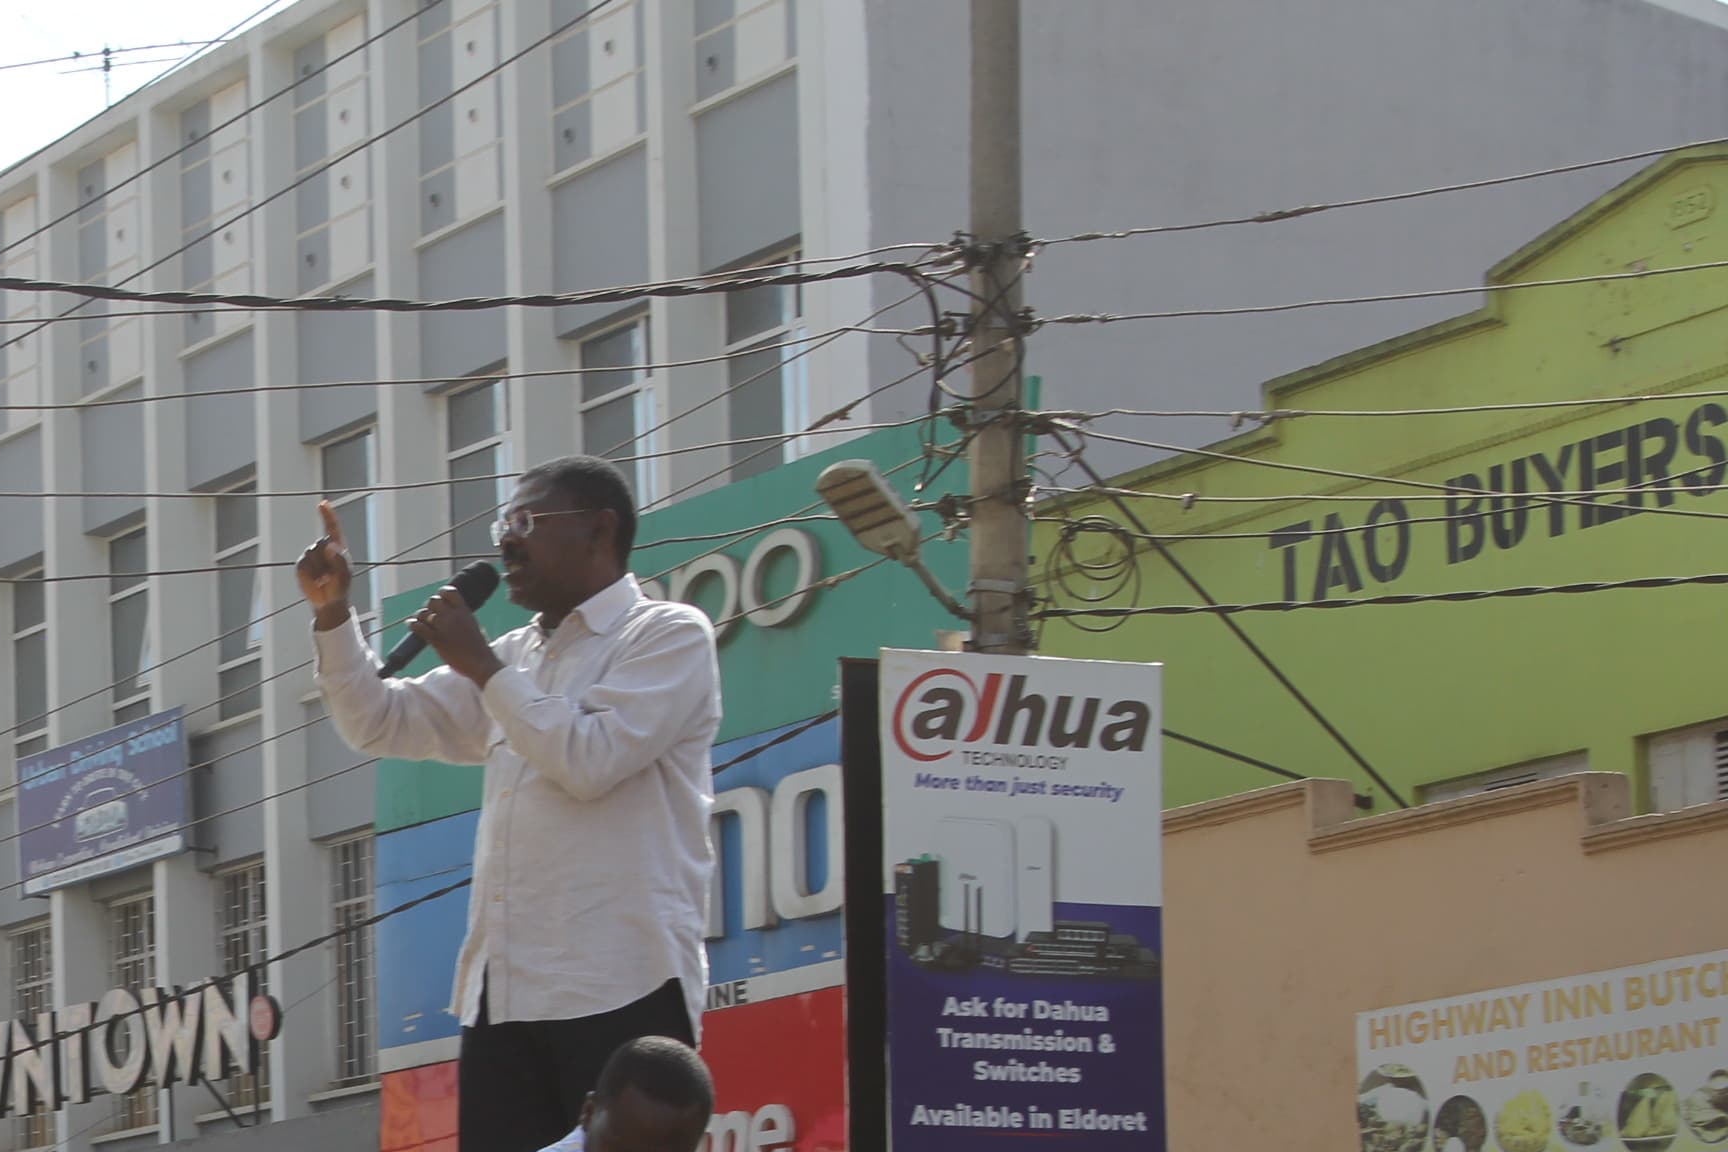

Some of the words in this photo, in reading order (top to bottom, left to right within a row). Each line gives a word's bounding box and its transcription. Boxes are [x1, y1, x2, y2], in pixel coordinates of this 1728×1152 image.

[1447, 403, 1728, 565] BUYERS
[962, 750, 1067, 771] TECHNOLOGY
[914, 772, 961, 792] More
[965, 775, 1008, 794] than
[1009, 778, 1049, 799] just
[1052, 781, 1124, 803] security
[943, 997, 989, 1019] Ask
[993, 998, 1029, 1020] for
[1033, 1000, 1110, 1023] Dahua
[1367, 993, 1531, 1051] HIGHWAY
[1542, 981, 1613, 1024] INN
[936, 1027, 1094, 1054] Transmission
[1098, 1033, 1116, 1054] &
[1451, 1049, 1518, 1084] AND
[1526, 1016, 1722, 1075] RESTAURANT
[973, 1060, 1082, 1084] Switches
[910, 1104, 1025, 1130] Available
[1028, 1107, 1054, 1130] in
[1058, 1108, 1148, 1132] Eldoret
